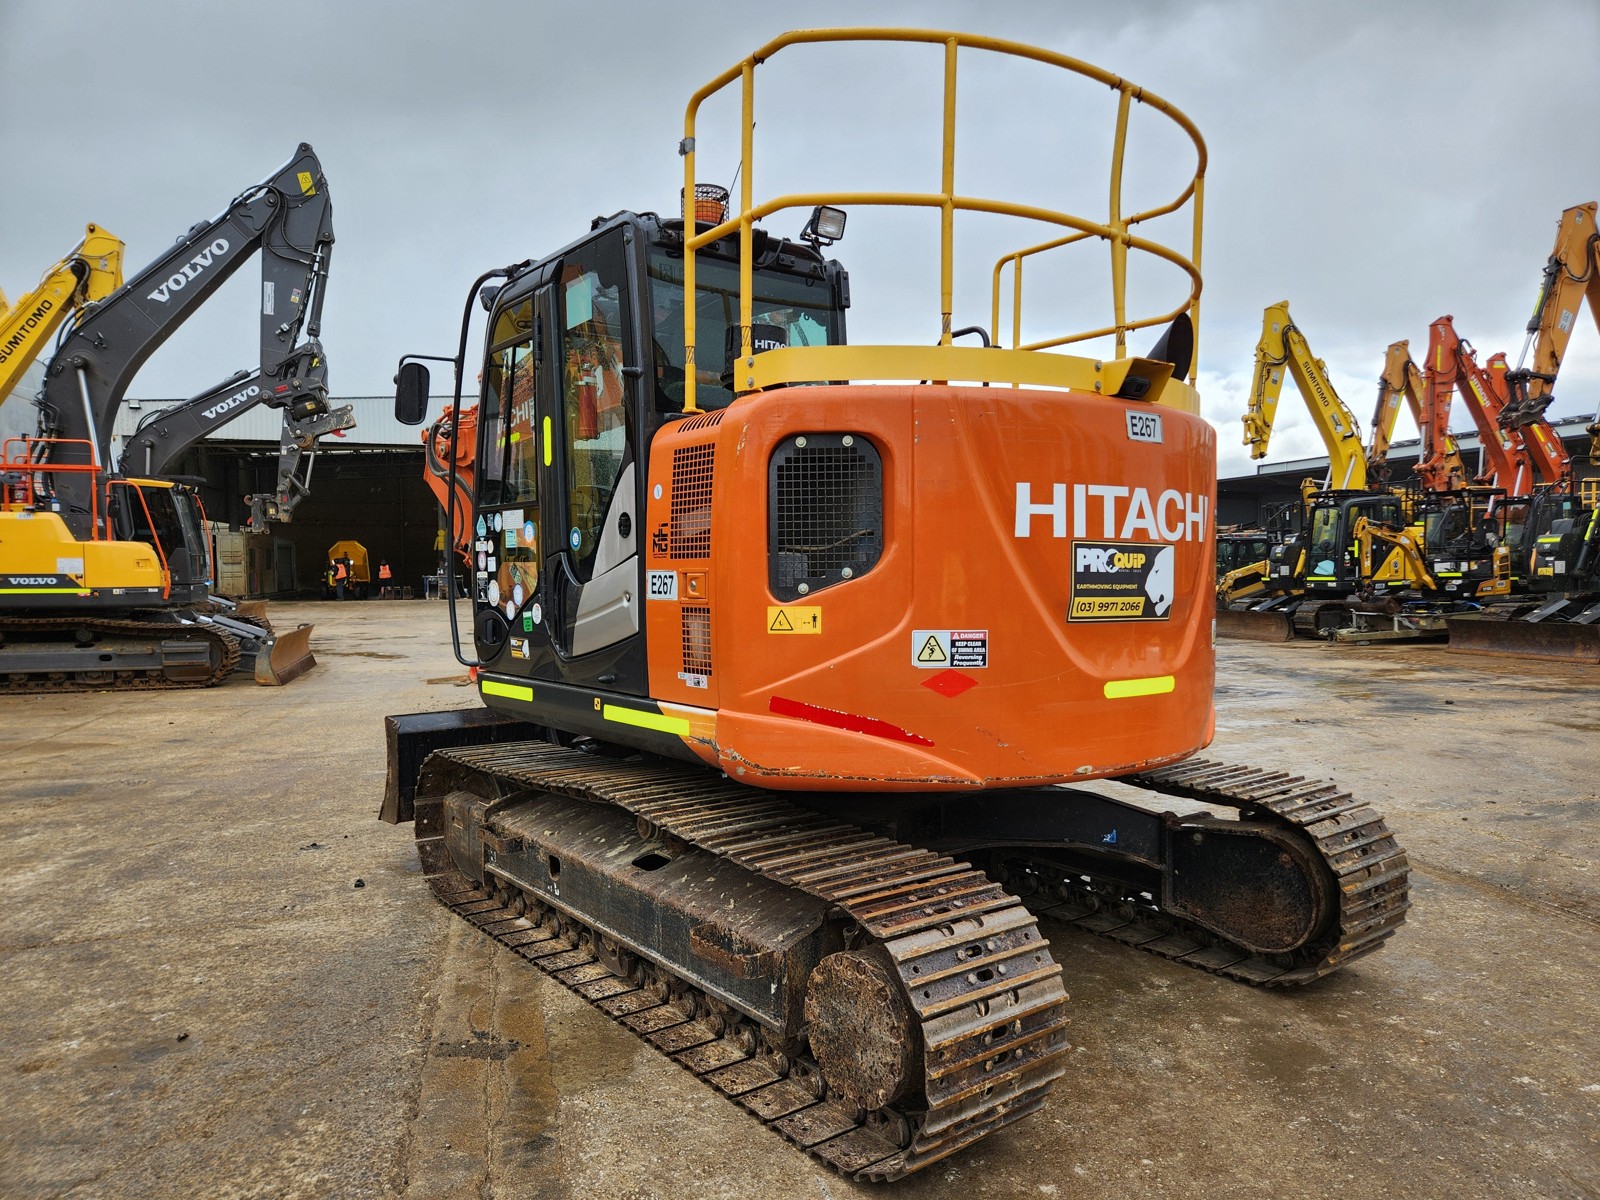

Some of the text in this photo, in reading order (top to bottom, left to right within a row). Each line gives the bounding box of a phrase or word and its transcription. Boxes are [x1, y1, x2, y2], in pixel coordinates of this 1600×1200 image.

[147, 238, 230, 303] VOLVO
[0, 299, 53, 364] SUMITOMO
[1303, 361, 1330, 407] SUMITOMO
[1471, 374, 1491, 408] HITACHI
[201, 385, 260, 419] VOLVO
[1130, 415, 1157, 438] E267
[1014, 482, 1209, 542] HITACHI
[8, 577, 57, 585] VOLVO
[651, 574, 674, 595] E267
[1076, 601, 1141, 613] (03) 9971 2066
